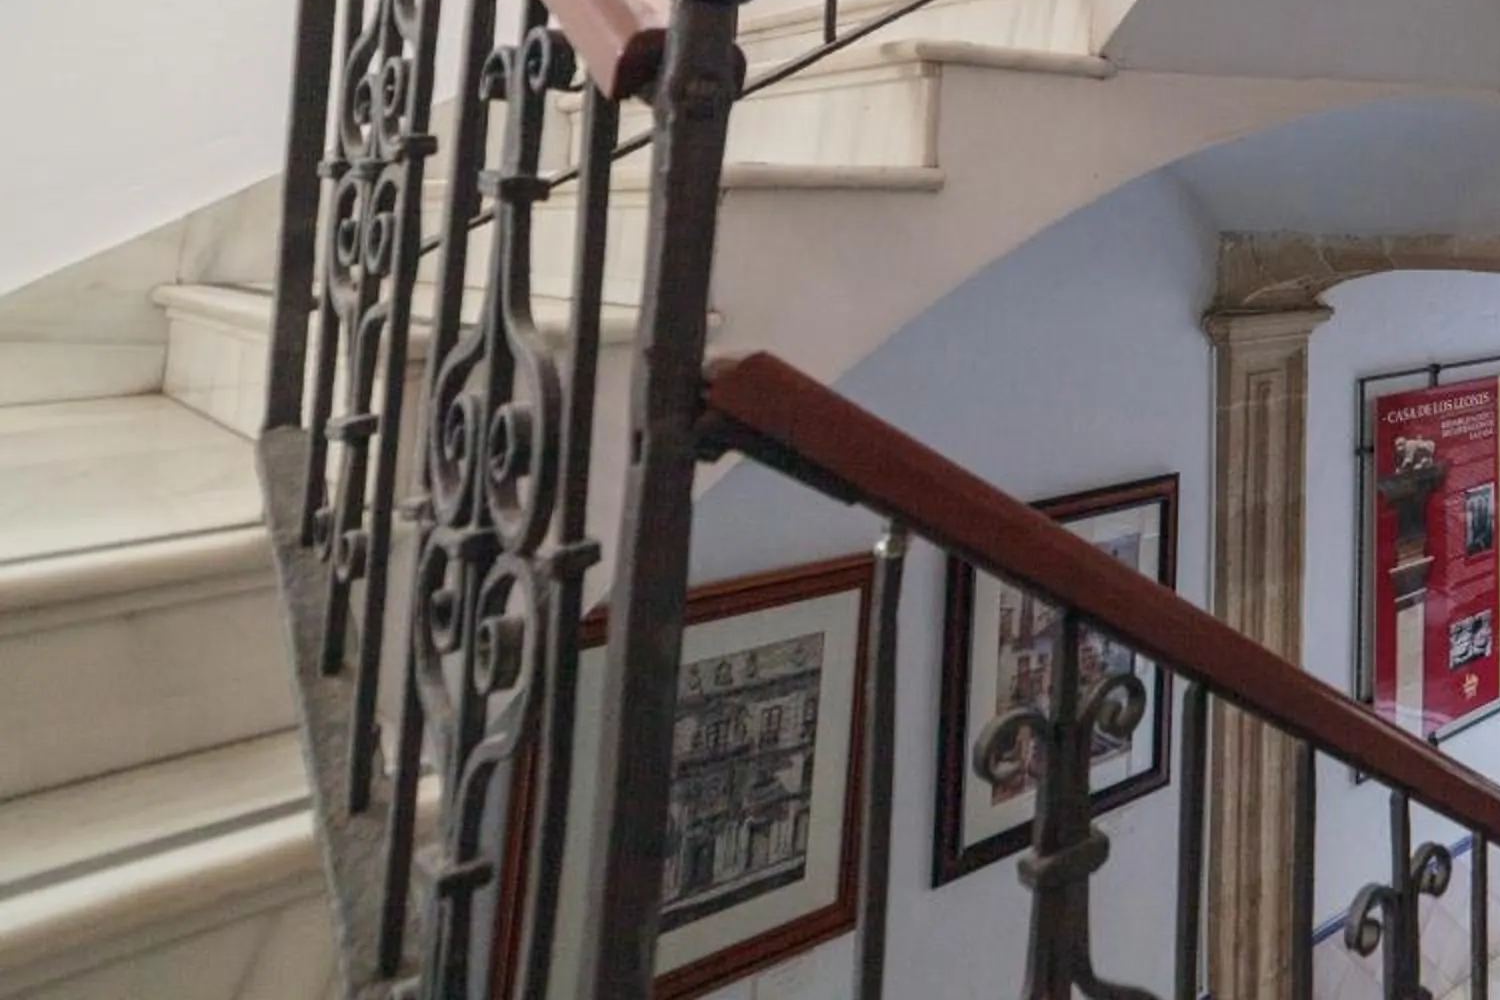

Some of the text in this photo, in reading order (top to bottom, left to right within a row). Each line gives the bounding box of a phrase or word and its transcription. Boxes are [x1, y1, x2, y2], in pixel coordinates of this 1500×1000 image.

[1387, 407, 1416, 424] CASA
[1417, 402, 1432, 418] DE
[1433, 399, 1453, 414] LOS
